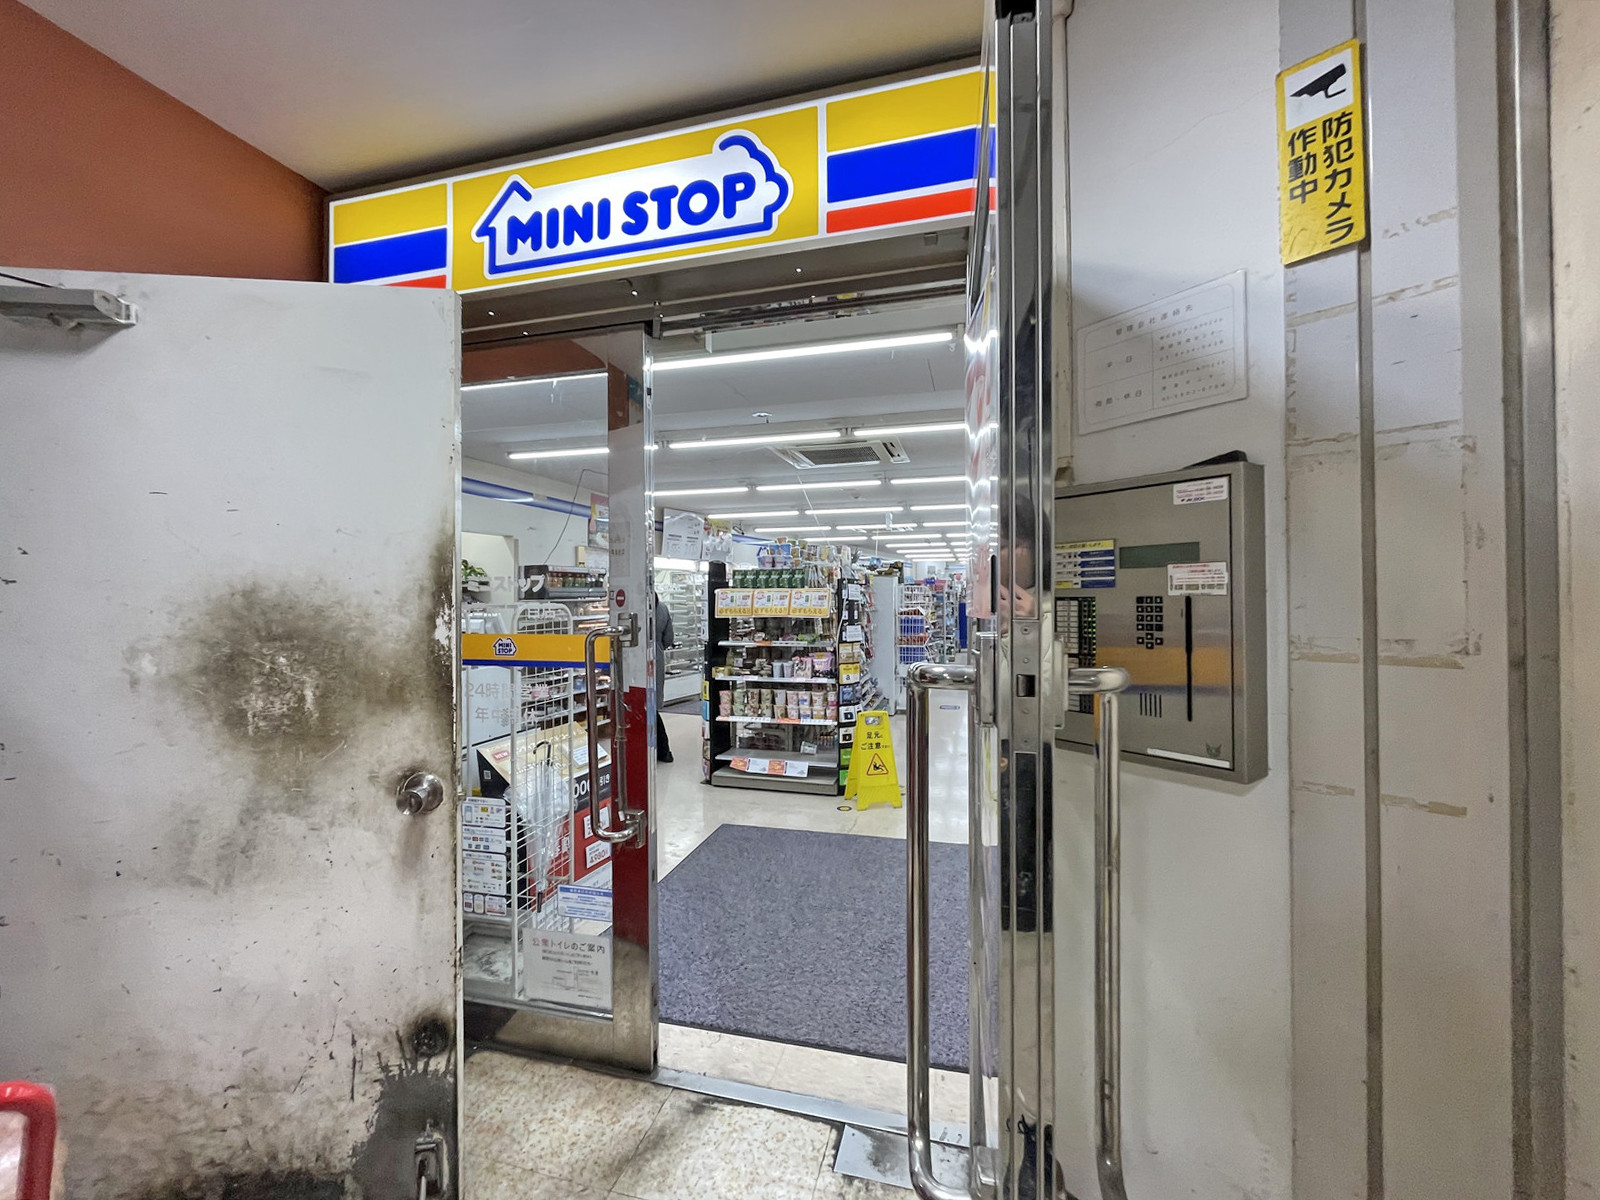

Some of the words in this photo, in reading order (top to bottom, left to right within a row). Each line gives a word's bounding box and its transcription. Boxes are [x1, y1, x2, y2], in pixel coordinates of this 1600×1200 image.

[1288, 126, 1317, 203] 作動中
[1322, 111, 1354, 244] 防犯カメラ
[507, 197, 611, 255] MINI
[621, 171, 756, 236] STOP
[494, 751, 509, 760] NEW
